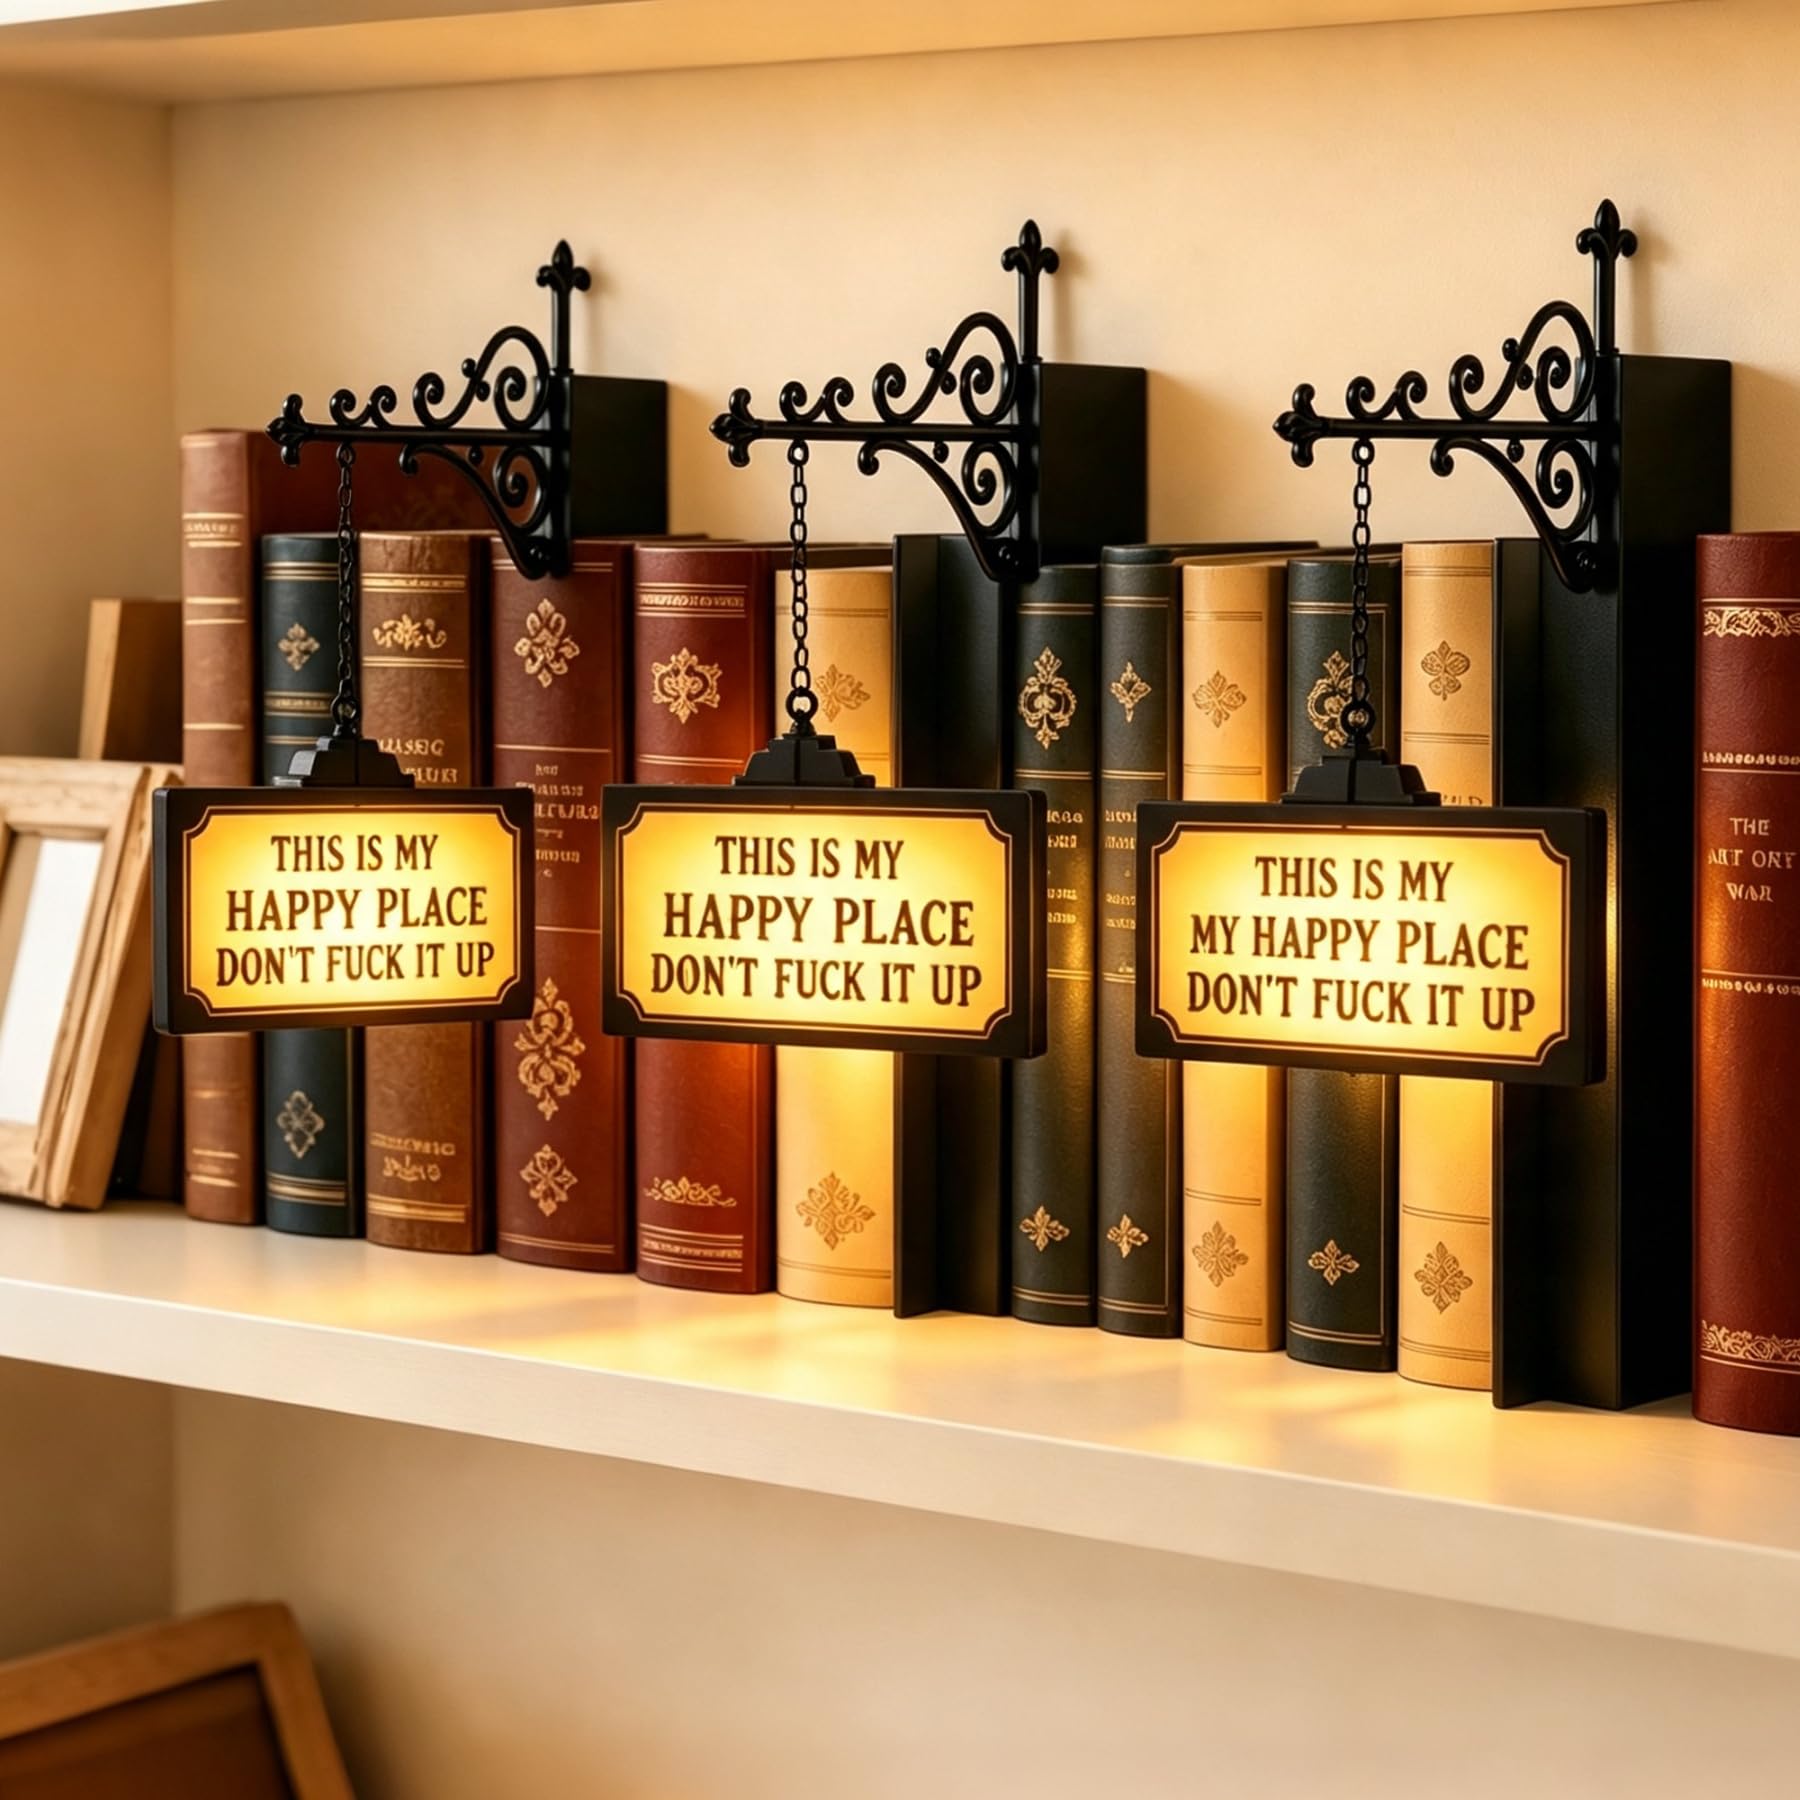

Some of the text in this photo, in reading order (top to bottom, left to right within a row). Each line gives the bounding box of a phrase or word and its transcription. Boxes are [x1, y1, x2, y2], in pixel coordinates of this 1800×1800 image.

[1729, 817, 1771, 836] THE
[271, 835, 439, 873] THIS IS MY
[714, 835, 905, 881] THIS IS MY
[1254, 855, 1454, 903] THIS IS MY
[225, 886, 488, 932] HAPPY PLACE
[663, 892, 975, 947] HAPPY PLACE
[216, 941, 495, 987] DON'T FUCK IT UP
[1189, 914, 1529, 971] MY HAPPY PLACE
[651, 952, 983, 1008] DON'T FUCK IT UP
[1187, 971, 1536, 1032] DON'T FUCK IT UP
